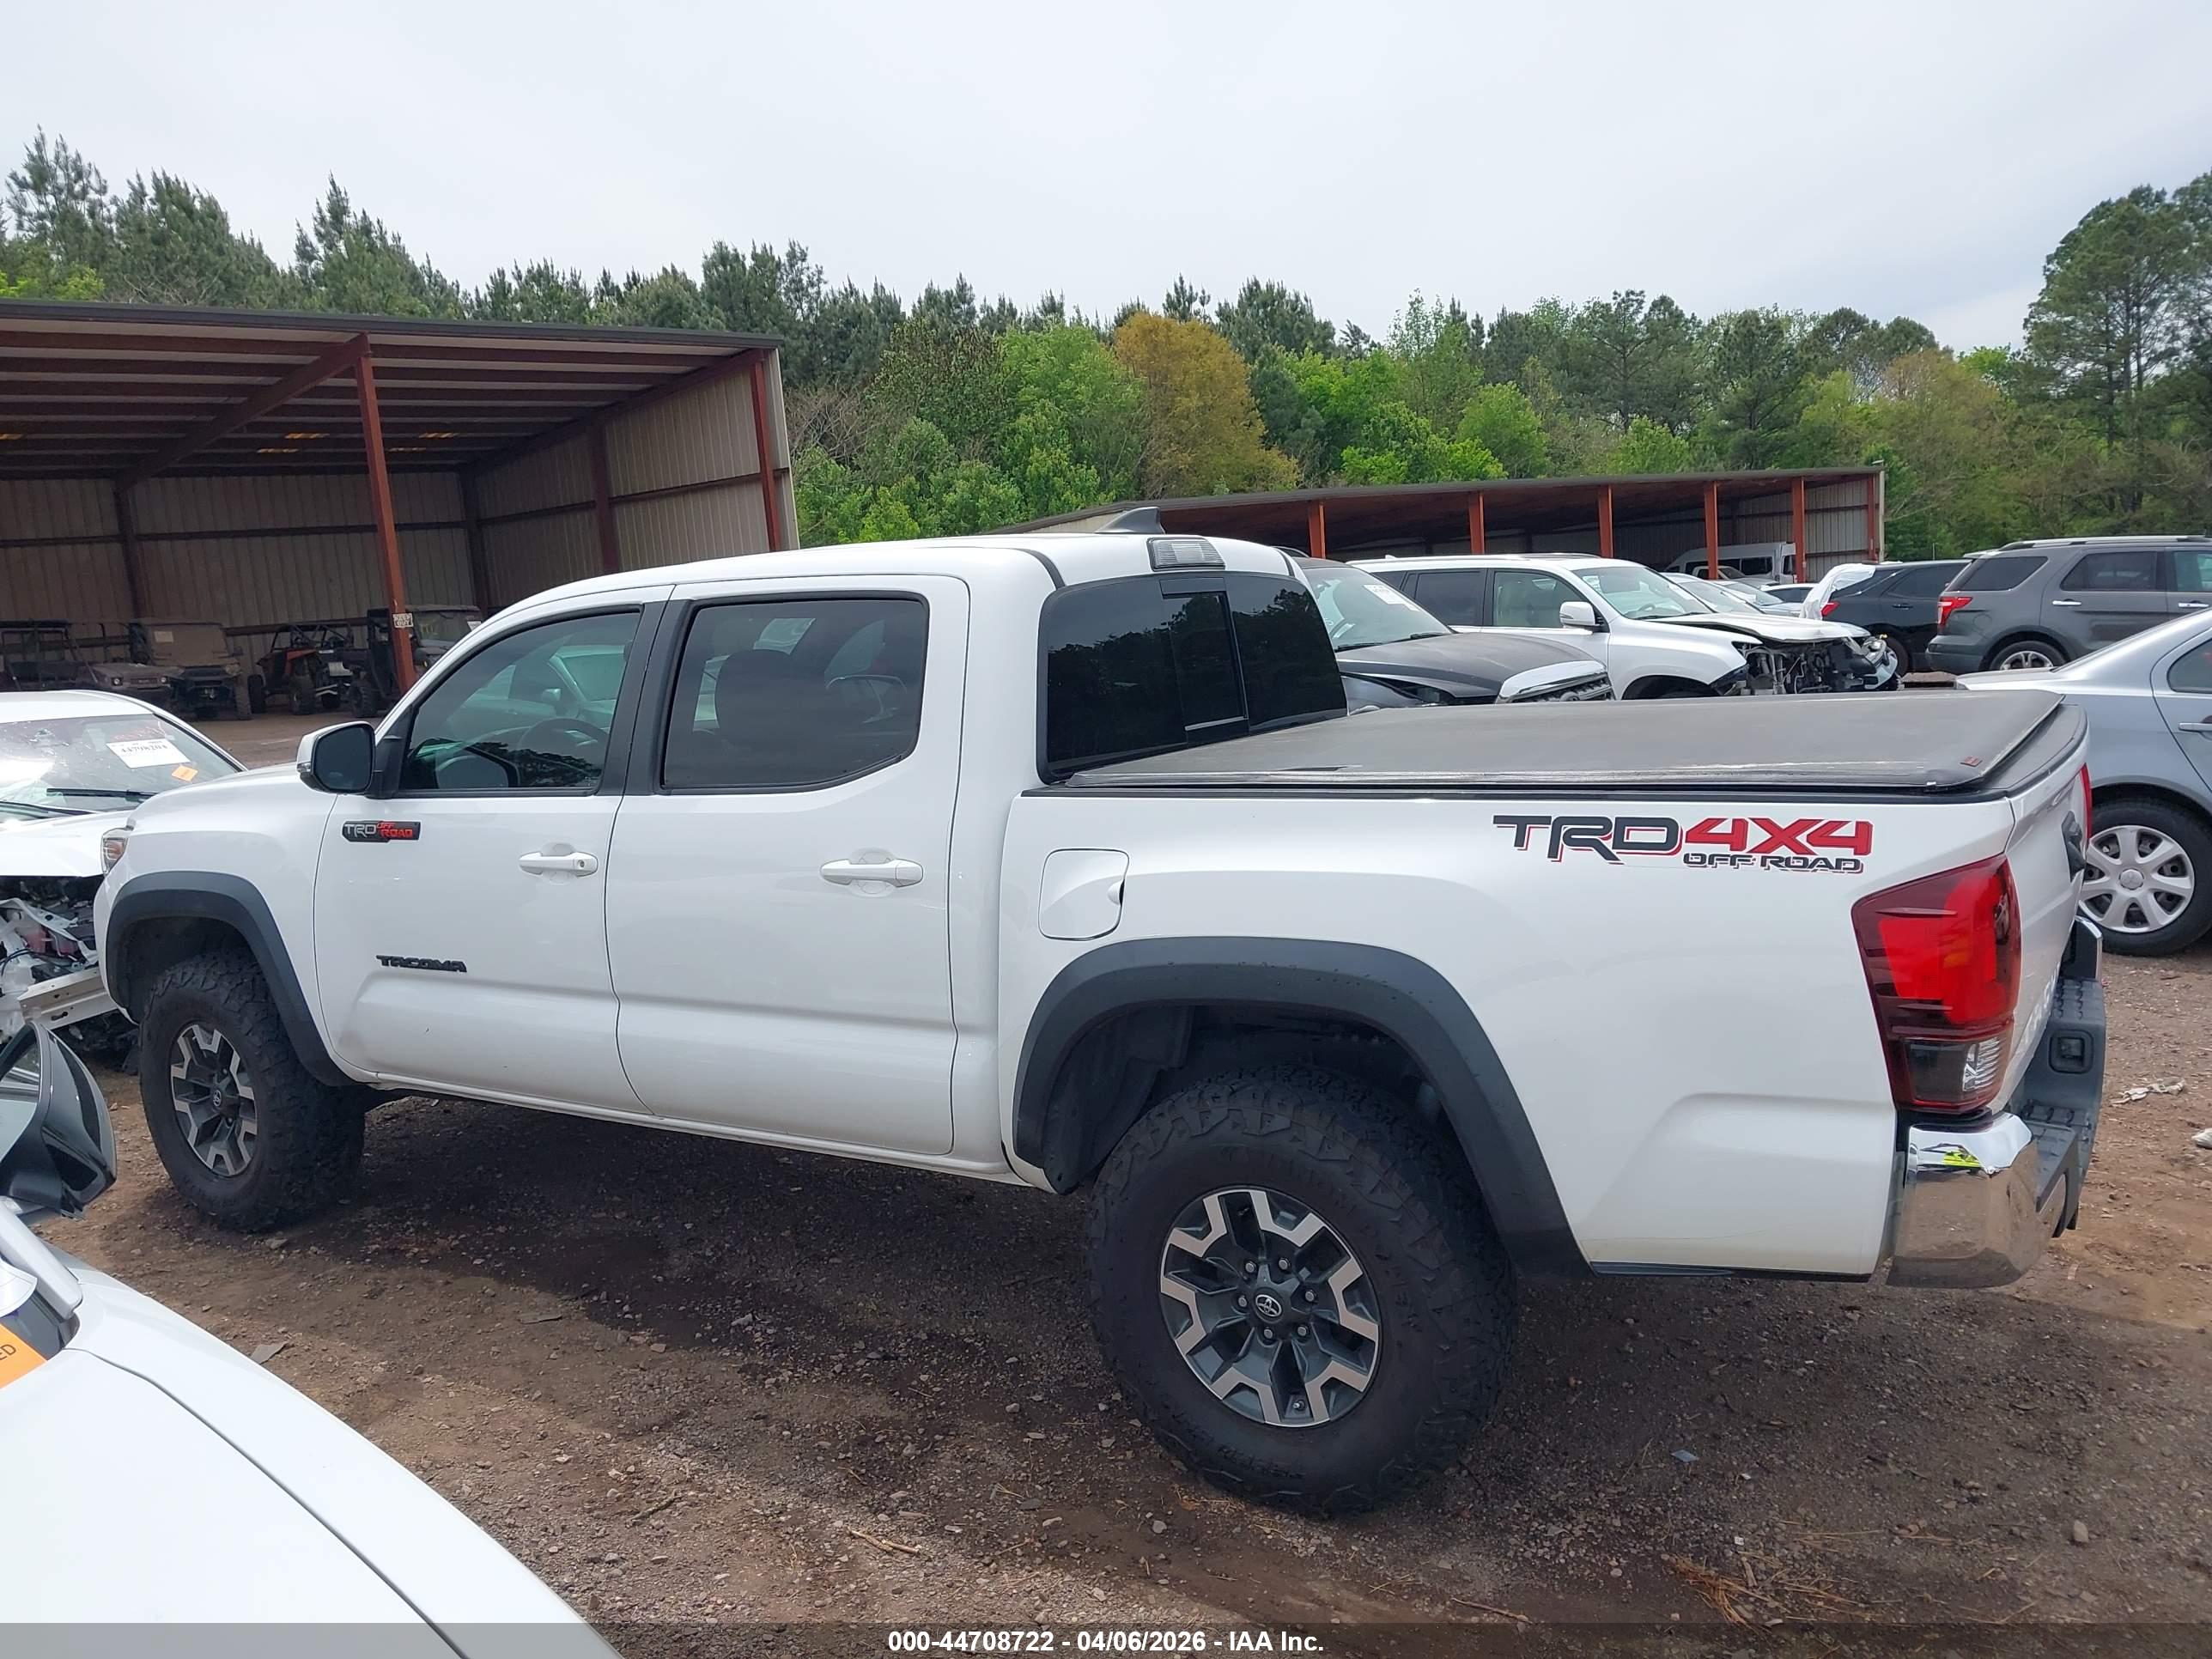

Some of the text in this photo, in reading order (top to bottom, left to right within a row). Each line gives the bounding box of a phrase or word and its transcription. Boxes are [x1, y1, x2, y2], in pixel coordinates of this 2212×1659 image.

[344, 823, 376, 837] TRD
[380, 829, 413, 838] ROAD
[1492, 815, 1874, 866] TRD 4X4
[1683, 853, 1864, 874] OFF ROAD
[375, 954, 467, 973] TACOMA
